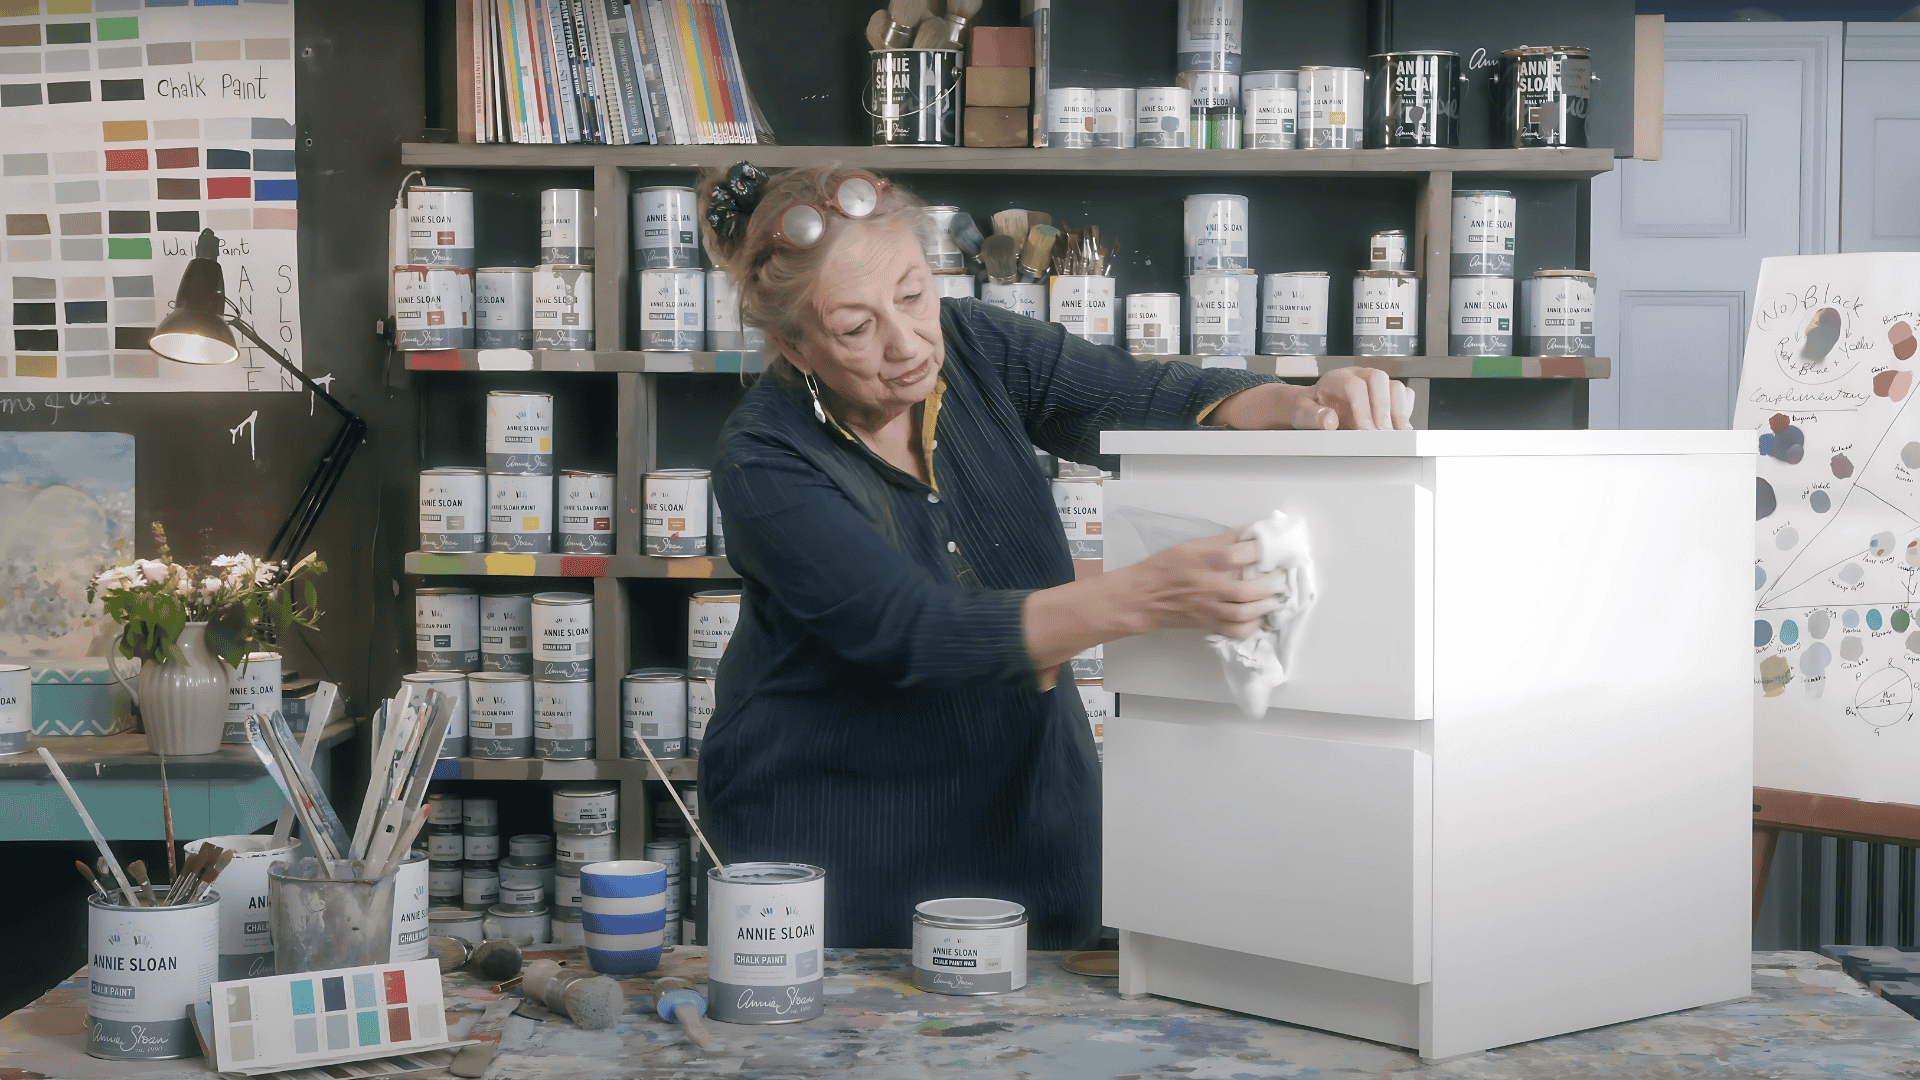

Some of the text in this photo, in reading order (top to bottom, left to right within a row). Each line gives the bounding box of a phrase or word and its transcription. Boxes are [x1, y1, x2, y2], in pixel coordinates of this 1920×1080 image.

[574, 2, 590, 61] PAINT EFFECTS
[564, 25, 576, 59] EFFECTS
[876, 58, 910, 73] ANNIE
[1520, 60, 1561, 76] ANNIE
[157, 65, 268, 100] Chalk Paint
[876, 74, 910, 89] SLAN
[1519, 76, 1562, 92] SLOAN
[1194, 98, 1229, 106] NNIE SLOA
[428, 216, 452, 224] SLOAN
[646, 214, 667, 222] ANNIE
[1471, 220, 1494, 228] ANNIE
[163, 237, 197, 257] Wall
[416, 295, 441, 304] SLOAN
[1061, 300, 1106, 308] ANNIE SLOAN
[1196, 301, 1238, 309] ANNIE SLOA
[1801, 284, 1863, 318] Black
[1357, 302, 1400, 310] ANNIE SLOAN
[1058, 507, 1097, 515] NNIE SLOAN
[544, 628, 589, 637] ANNIE SLOAN
[230, 686, 274, 695] NNIE SOAN
[400, 911, 420, 922] ANNIE
[738, 924, 815, 940] ANNIE SLOAN
[401, 933, 418, 943] CHALK
[933, 947, 952, 956] ANNIE
[94, 954, 177, 972] ANNIE SLOAN
[736, 955, 784, 964] CHALK PAINT
[92, 984, 132, 997] CHALK PAINT
[737, 986, 815, 1014] Annie Sloan
[93, 1022, 169, 1052] Annie Sloan
